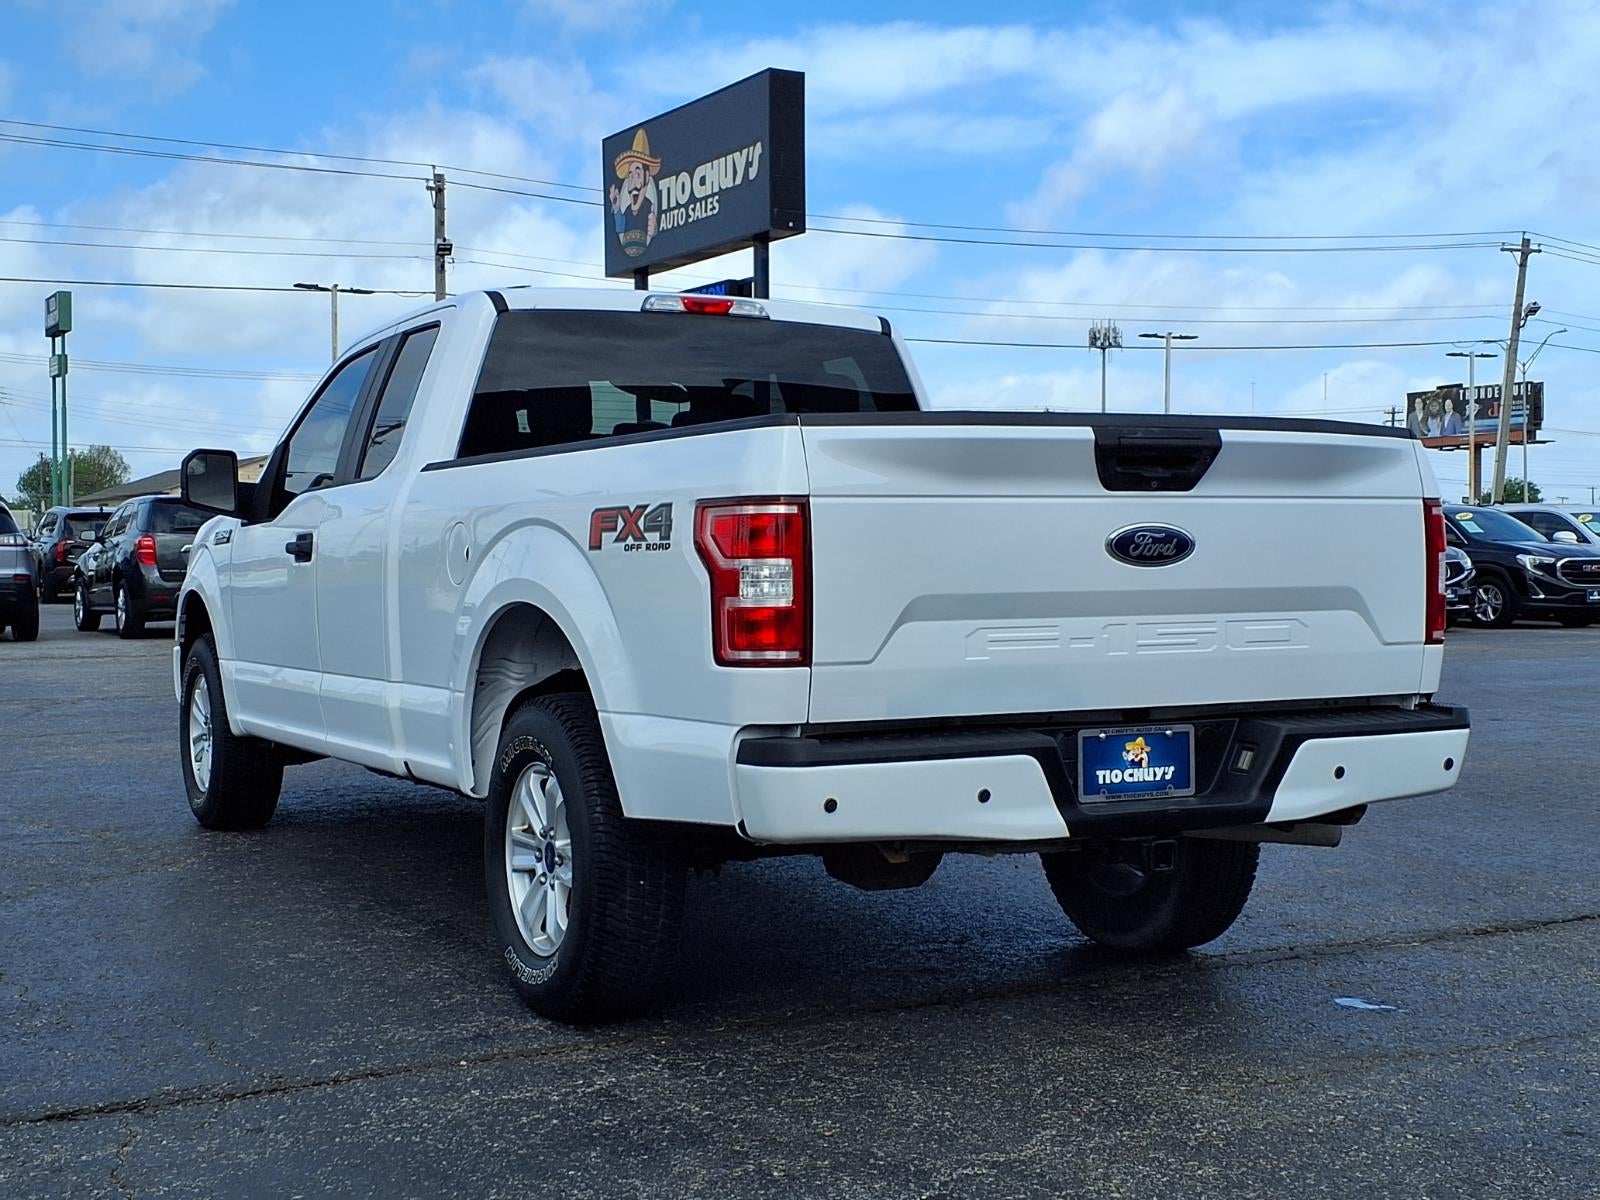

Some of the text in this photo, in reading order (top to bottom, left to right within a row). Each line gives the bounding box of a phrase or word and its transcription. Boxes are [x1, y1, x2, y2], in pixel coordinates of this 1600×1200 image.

[658, 140, 763, 211] TIO CHUY'S
[659, 195, 720, 232] AUTO SALES
[1458, 386, 1500, 401] THUNDE
[588, 501, 673, 551] FX4
[1128, 531, 1178, 557] Ford
[624, 542, 671, 552] OFF ROAD
[965, 618, 1310, 661] F-150
[500, 734, 554, 774] MICHELIN
[1096, 765, 1175, 785] TIO CHUY'S
[503, 944, 559, 986] MICHELIN
